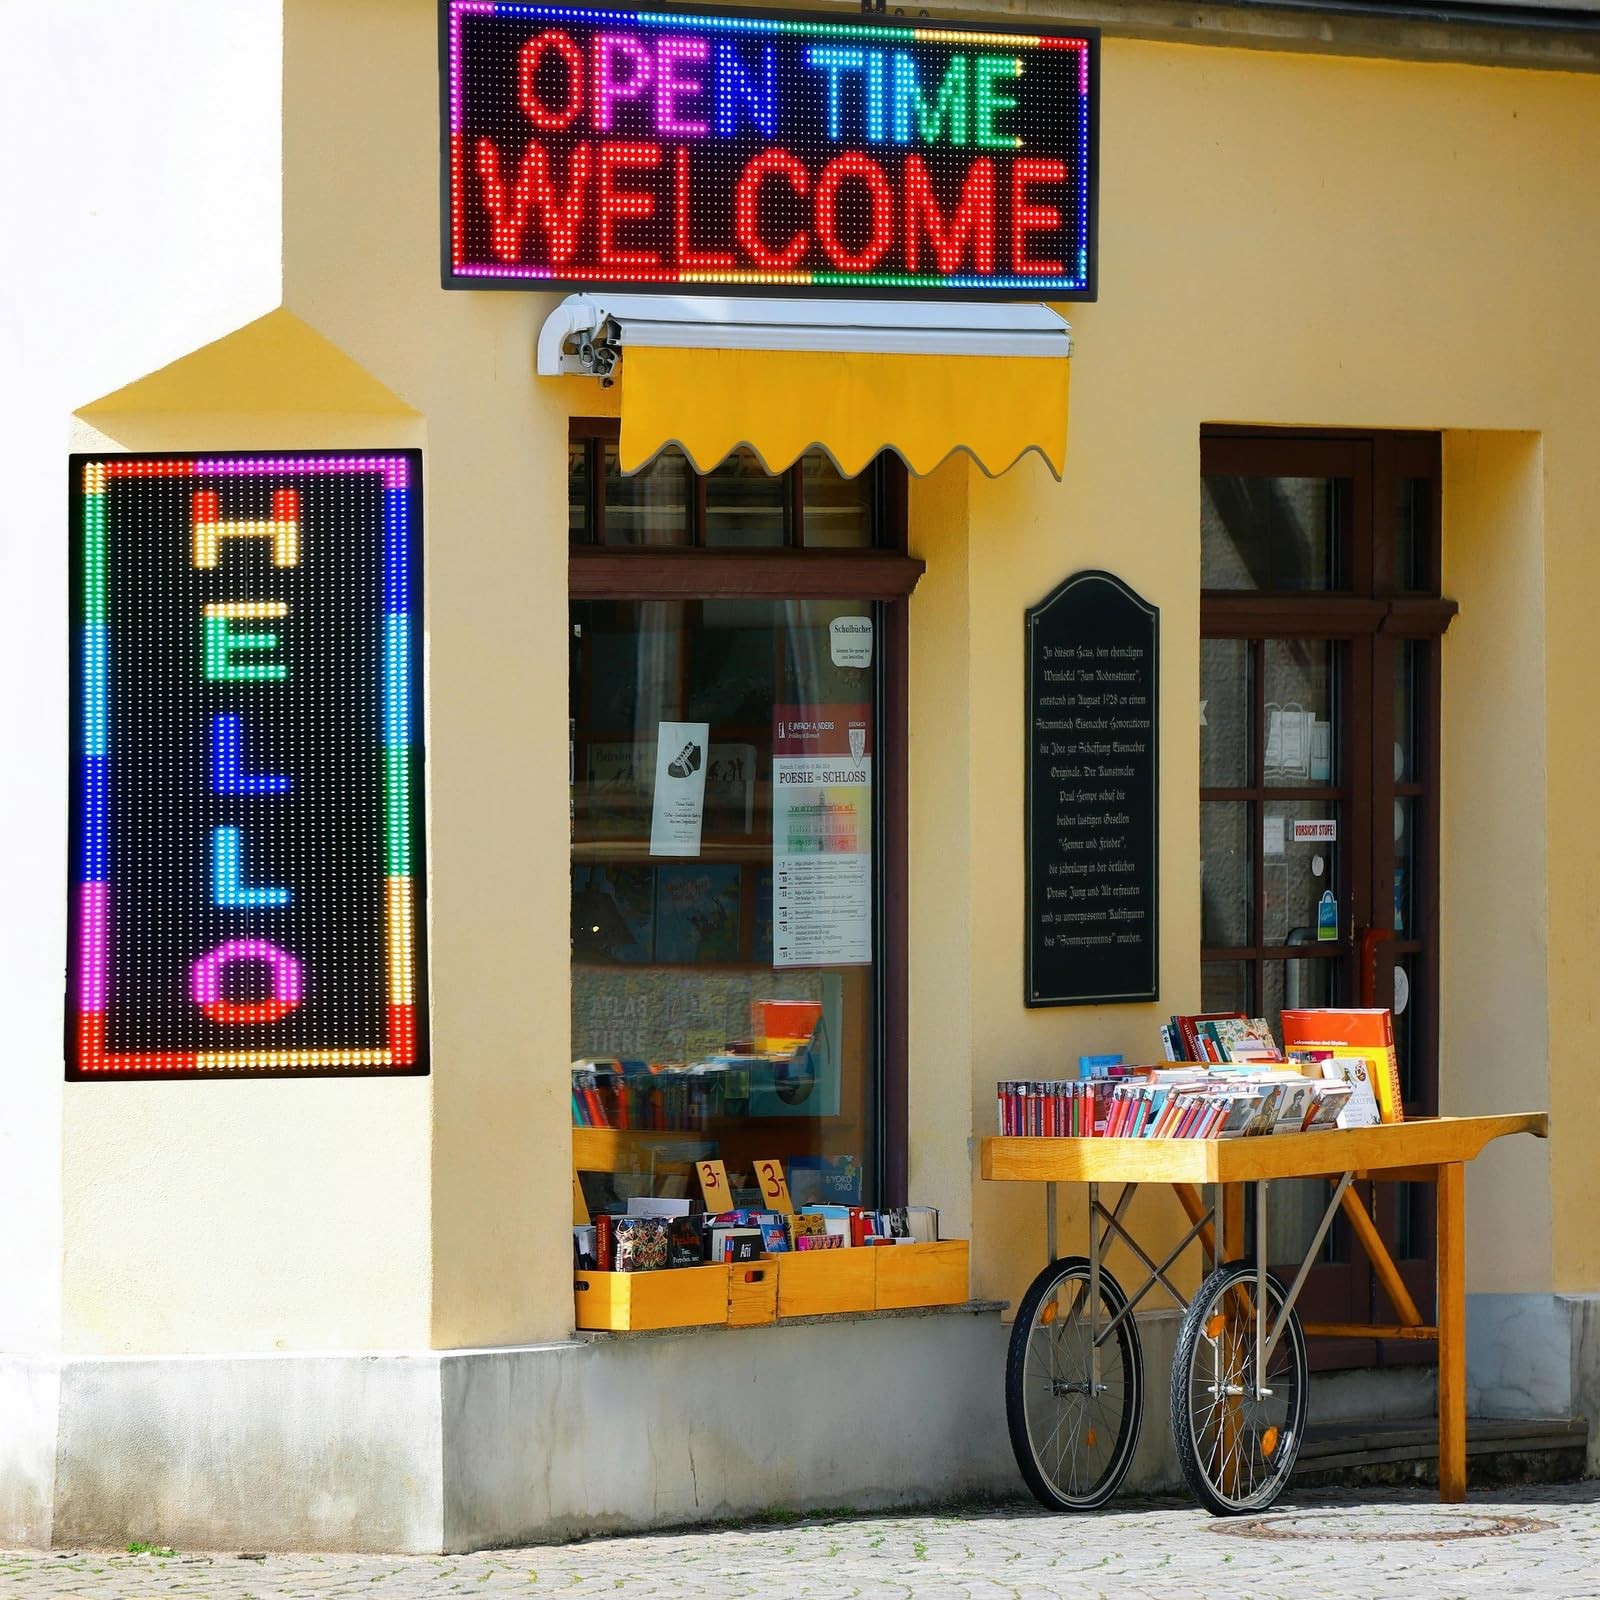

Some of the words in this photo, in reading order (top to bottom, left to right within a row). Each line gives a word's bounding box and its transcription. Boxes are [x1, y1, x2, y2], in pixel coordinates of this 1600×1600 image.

[517, 28, 775, 138] OPEN
[807, 46, 1025, 150] TIME
[478, 138, 1068, 276] WELCOME
[834, 624, 872, 634] Schulbücher
[1043, 646, 1052, 660] In
[1054, 647, 1074, 657] diesem
[1096, 647, 1109, 657] dem
[1110, 646, 1144, 660] ehemaligen
[1044, 669, 1075, 681] Weinlokal
[1040, 694, 1067, 706] entstand
[1068, 695, 1076, 705] im
[1078, 694, 1101, 709] August
[1103, 694, 1119, 705] 1928
[1120, 696, 1128, 705] an
[1129, 694, 1146, 705] einem
[1036, 718, 1074, 729] Stammtisch
[1076, 717, 1109, 729] Eisenacher
[1110, 716, 1150, 731] Honoratioren
[190, 488, 302, 1024] HELLO
[1040, 743, 1049, 754] die
[1051, 742, 1066, 756] Idee
[1068, 745, 1077, 757] zur
[1078, 741, 1111, 756] Schaffung
[1113, 741, 1145, 753] Eisenacher
[780, 771, 814, 784] POESIE
[823, 770, 867, 783] SCHLOSS
[1051, 766, 1082, 781] Originale.
[1084, 766, 1097, 777] Der
[1098, 765, 1135, 777] Kunstmaler
[1060, 789, 1075, 804] Paul
[1099, 789, 1116, 802] schuf
[1117, 789, 1125, 801] die
[1057, 814, 1076, 826] beiden
[1078, 814, 1102, 828] lustigen
[1104, 812, 1130, 825] Gesellen
[1296, 824, 1318, 836] VORSICHT
[1319, 824, 1335, 836] STUFE!
[1085, 838, 1098, 849] und
[1049, 863, 1058, 874] die
[1059, 862, 1088, 877] jahrelang
[1089, 863, 1096, 873] in
[1097, 862, 1107, 873] der
[1047, 887, 1068, 900] Presse
[1069, 885, 1087, 901] Jung
[1088, 886, 1100, 897] und
[1101, 885, 1112, 896] Alt
[1042, 912, 1053, 923] und
[1055, 915, 1062, 925] zu
[1045, 936, 1055, 947] des
[831, 1175, 853, 1184] YOKO
